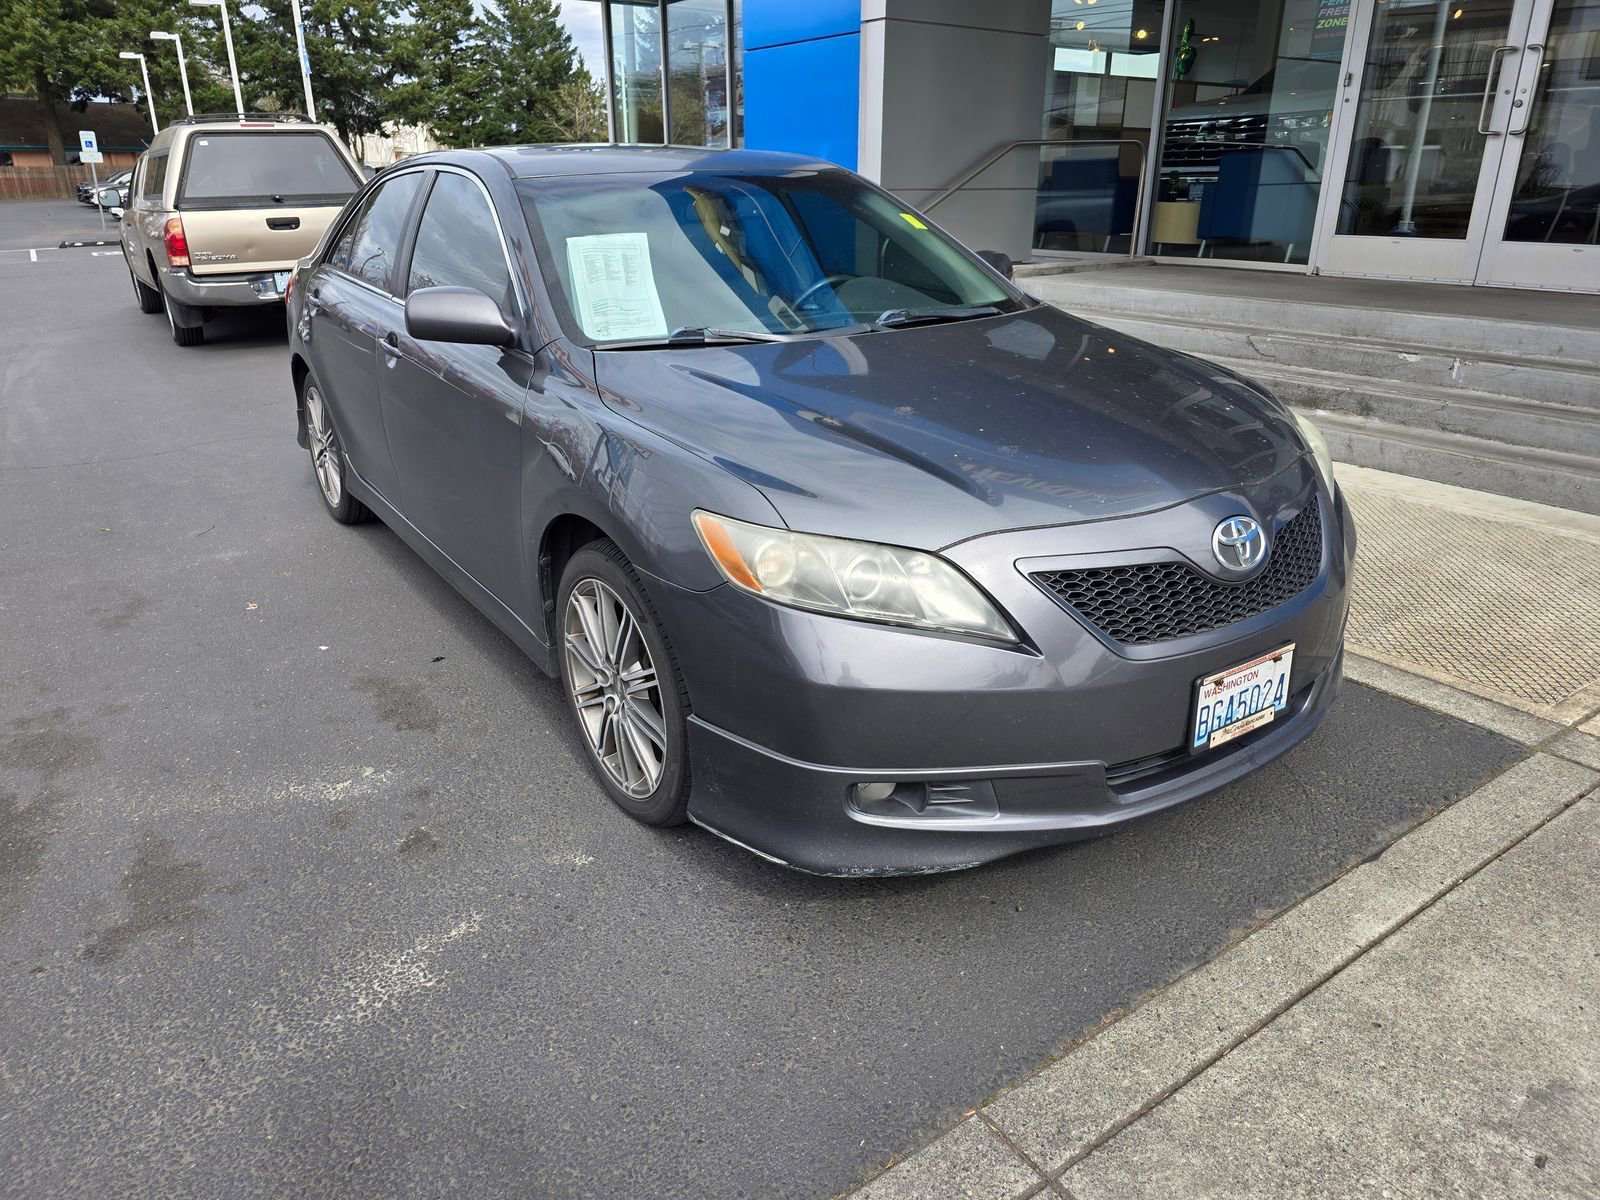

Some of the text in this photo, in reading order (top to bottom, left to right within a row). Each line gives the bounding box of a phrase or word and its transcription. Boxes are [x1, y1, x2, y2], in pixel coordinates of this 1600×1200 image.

[1318, 6, 1350, 17] FREE
[1316, 17, 1349, 29] ZONE
[1204, 670, 1259, 699] WASHINGTON
[1196, 672, 1285, 741] BGA5024
